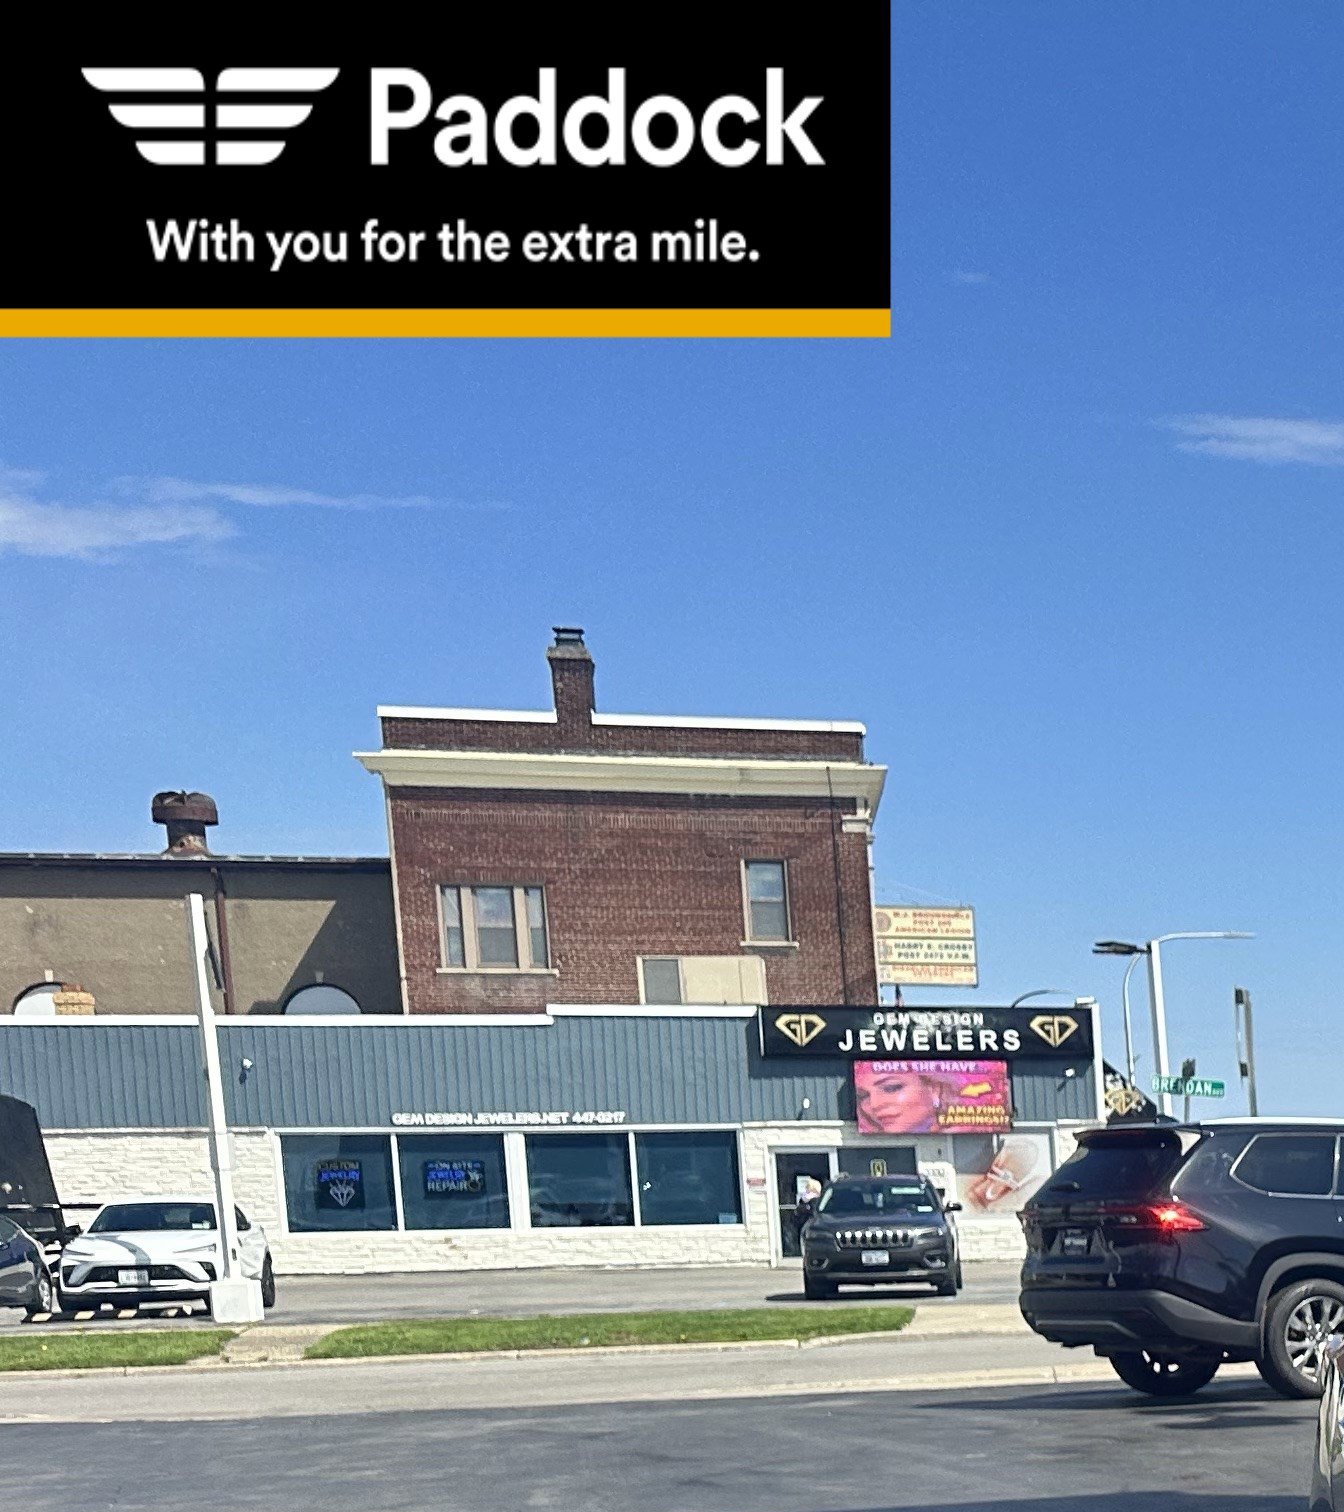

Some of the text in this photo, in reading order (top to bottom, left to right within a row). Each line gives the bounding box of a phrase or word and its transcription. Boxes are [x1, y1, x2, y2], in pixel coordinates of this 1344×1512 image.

[838, 1029, 1021, 1051] JEWELERS
[425, 1112, 473, 1125] DESIGN
[427, 1180, 467, 1192] REPAIR
